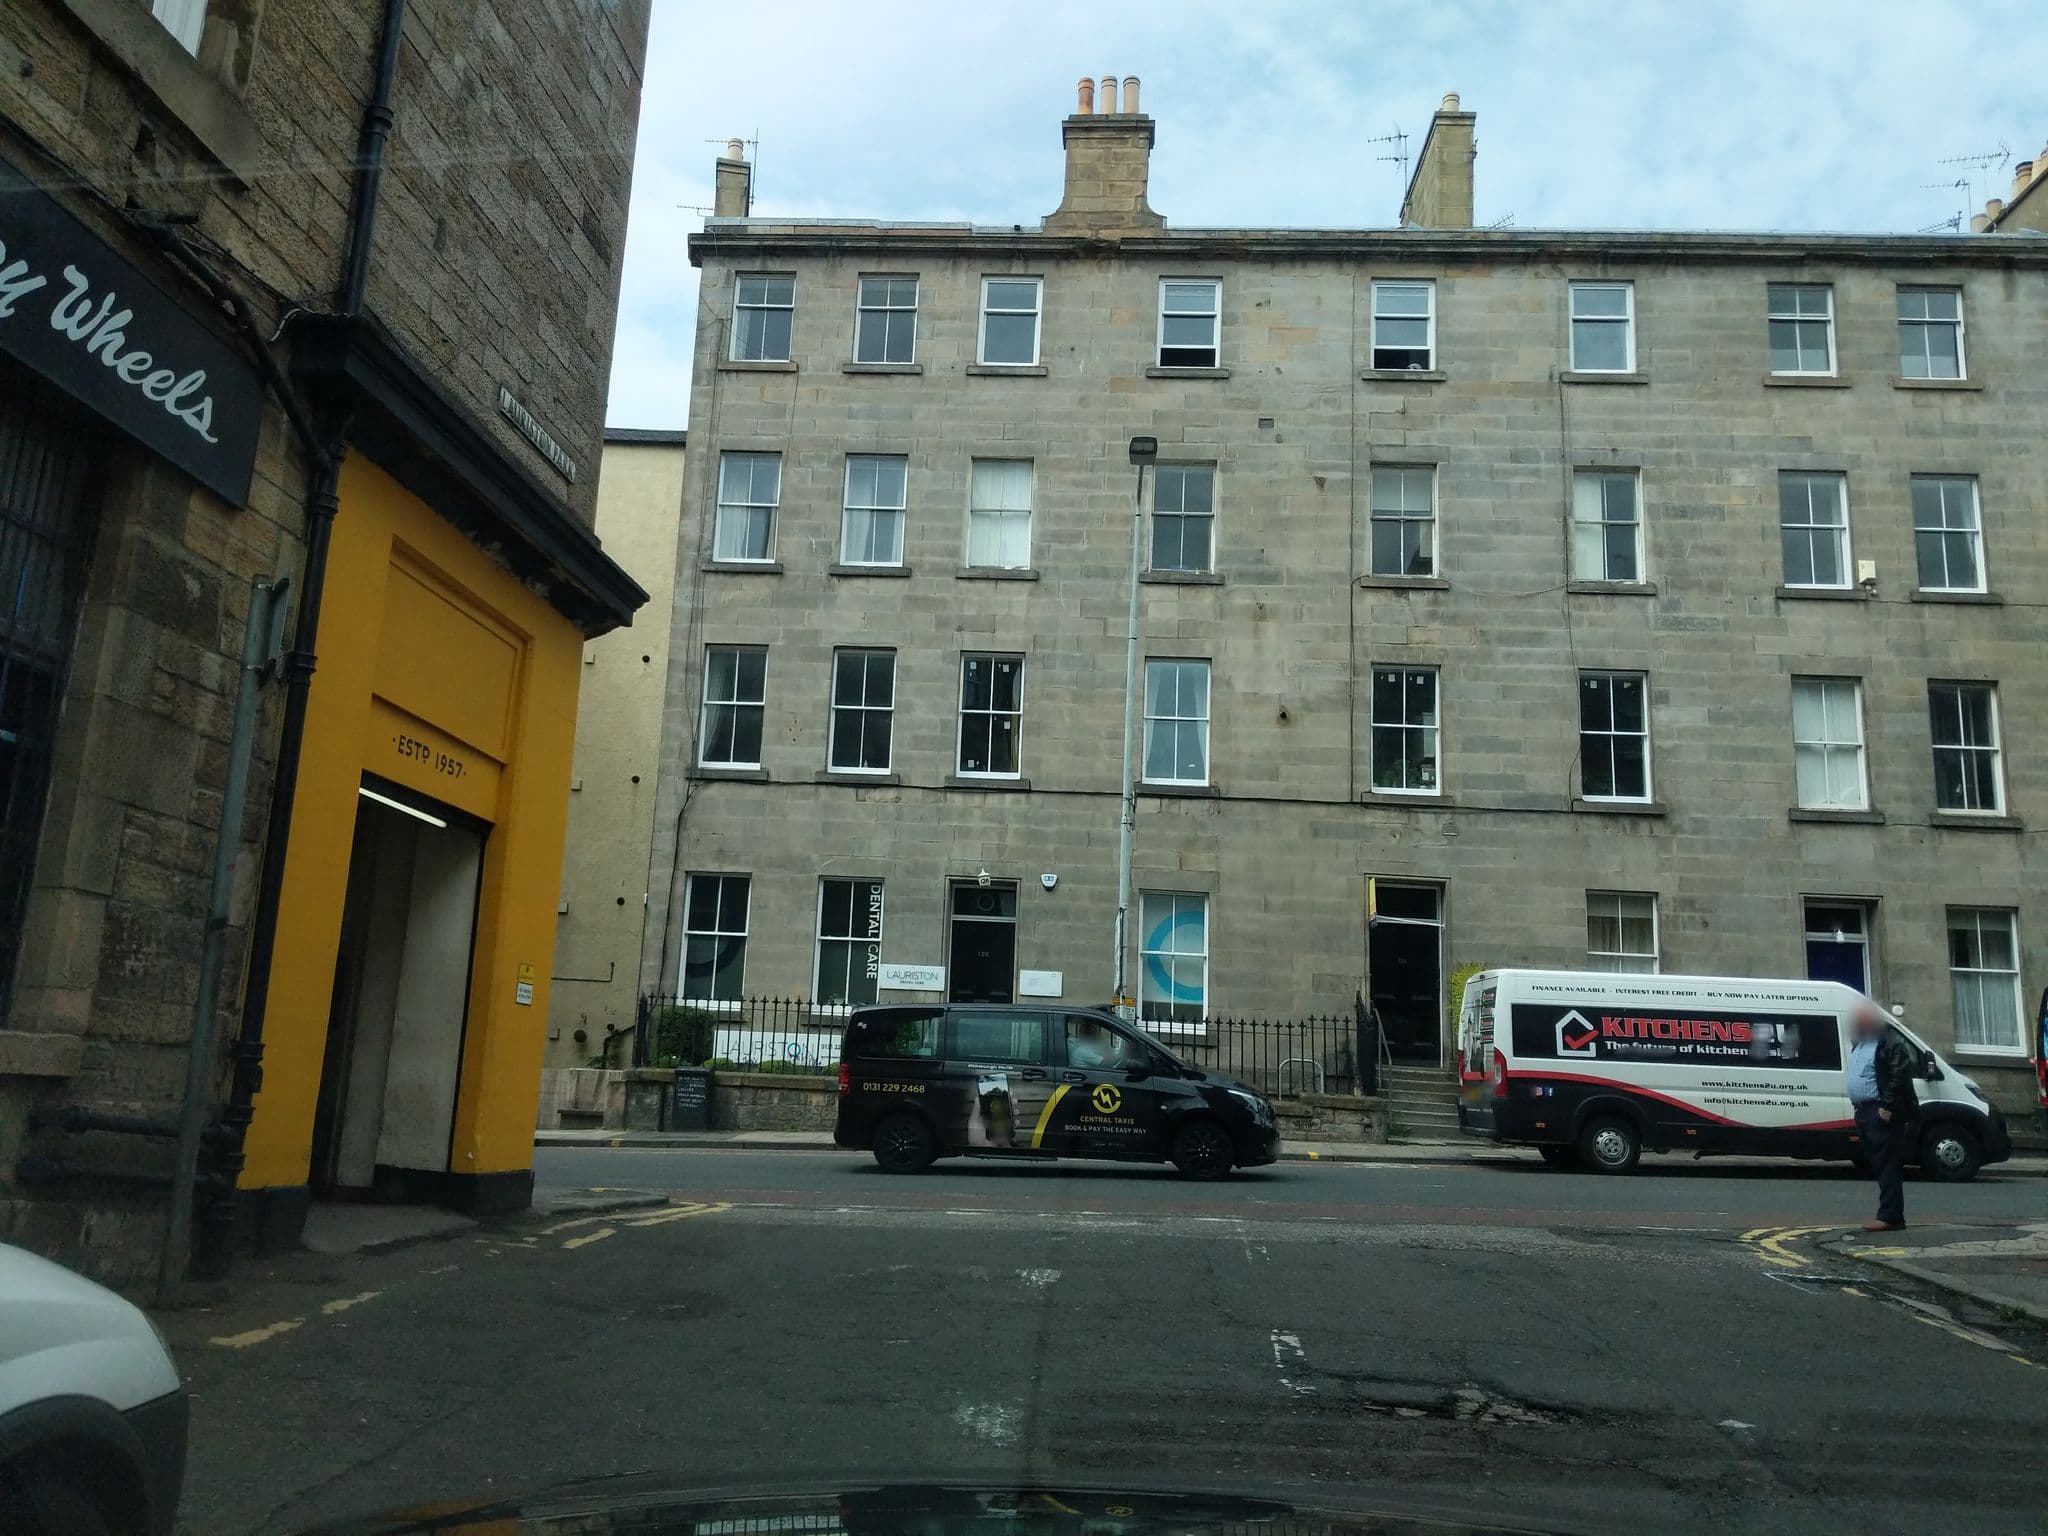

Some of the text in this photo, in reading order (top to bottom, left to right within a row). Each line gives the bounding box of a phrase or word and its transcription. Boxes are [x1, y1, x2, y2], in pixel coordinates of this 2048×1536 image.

[51, 265, 218, 443] Wheels
[434, 752, 463, 778] 1957
[866, 884, 881, 980] DENTAL CARE
[886, 970, 938, 981] LAURISTON
[721, 1040, 817, 1061] LAURISTON
[1680, 1044, 1693, 1053] of
[1696, 1044, 1749, 1056] kitchen
[863, 1082, 925, 1093] 0131 229 2468
[1701, 1081, 1808, 1091] www.kitchens2u.org.uk
[1704, 1097, 1809, 1107] info@kitchens2u.org.uk
[1080, 1115, 1135, 1125] CENTRAL TAXIS
[1133, 1127, 1147, 1135] WAY
